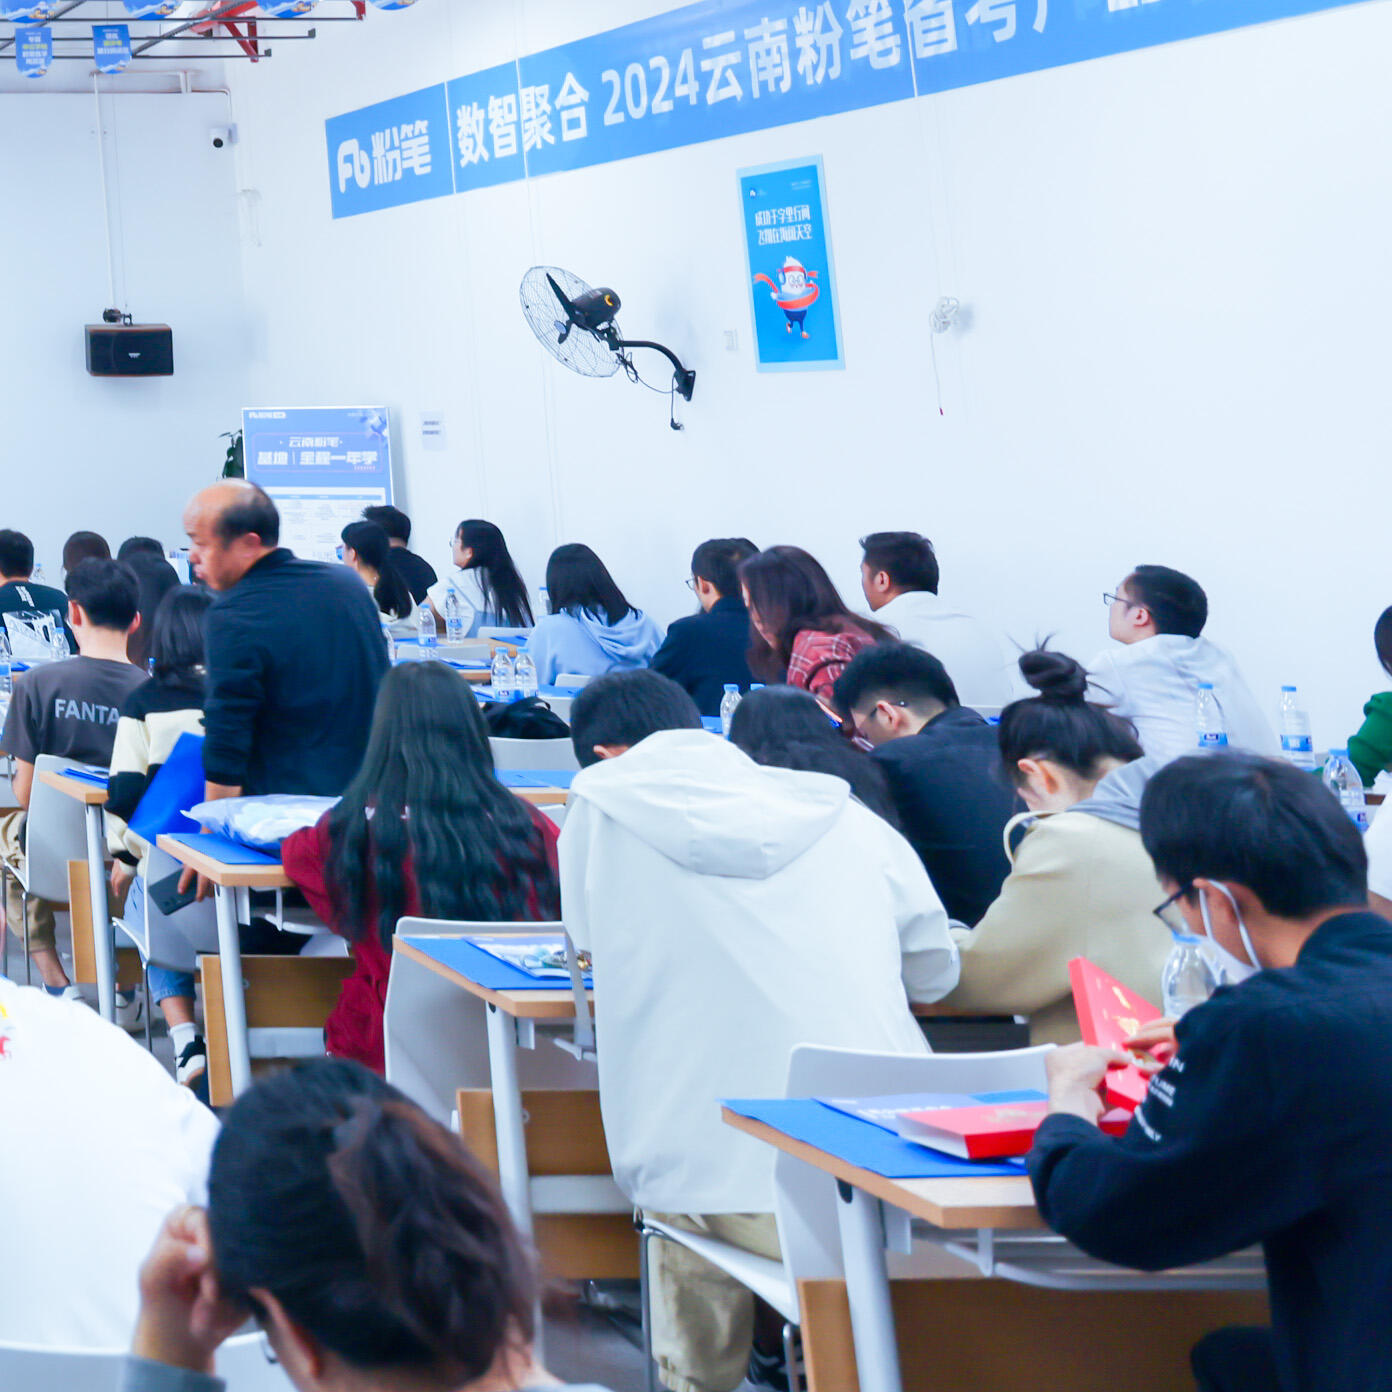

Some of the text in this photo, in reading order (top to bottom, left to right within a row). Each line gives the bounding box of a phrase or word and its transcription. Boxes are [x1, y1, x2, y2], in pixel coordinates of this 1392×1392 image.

[455, 71, 590, 168] 数智聚合
[54, 698, 121, 725] FANTA
